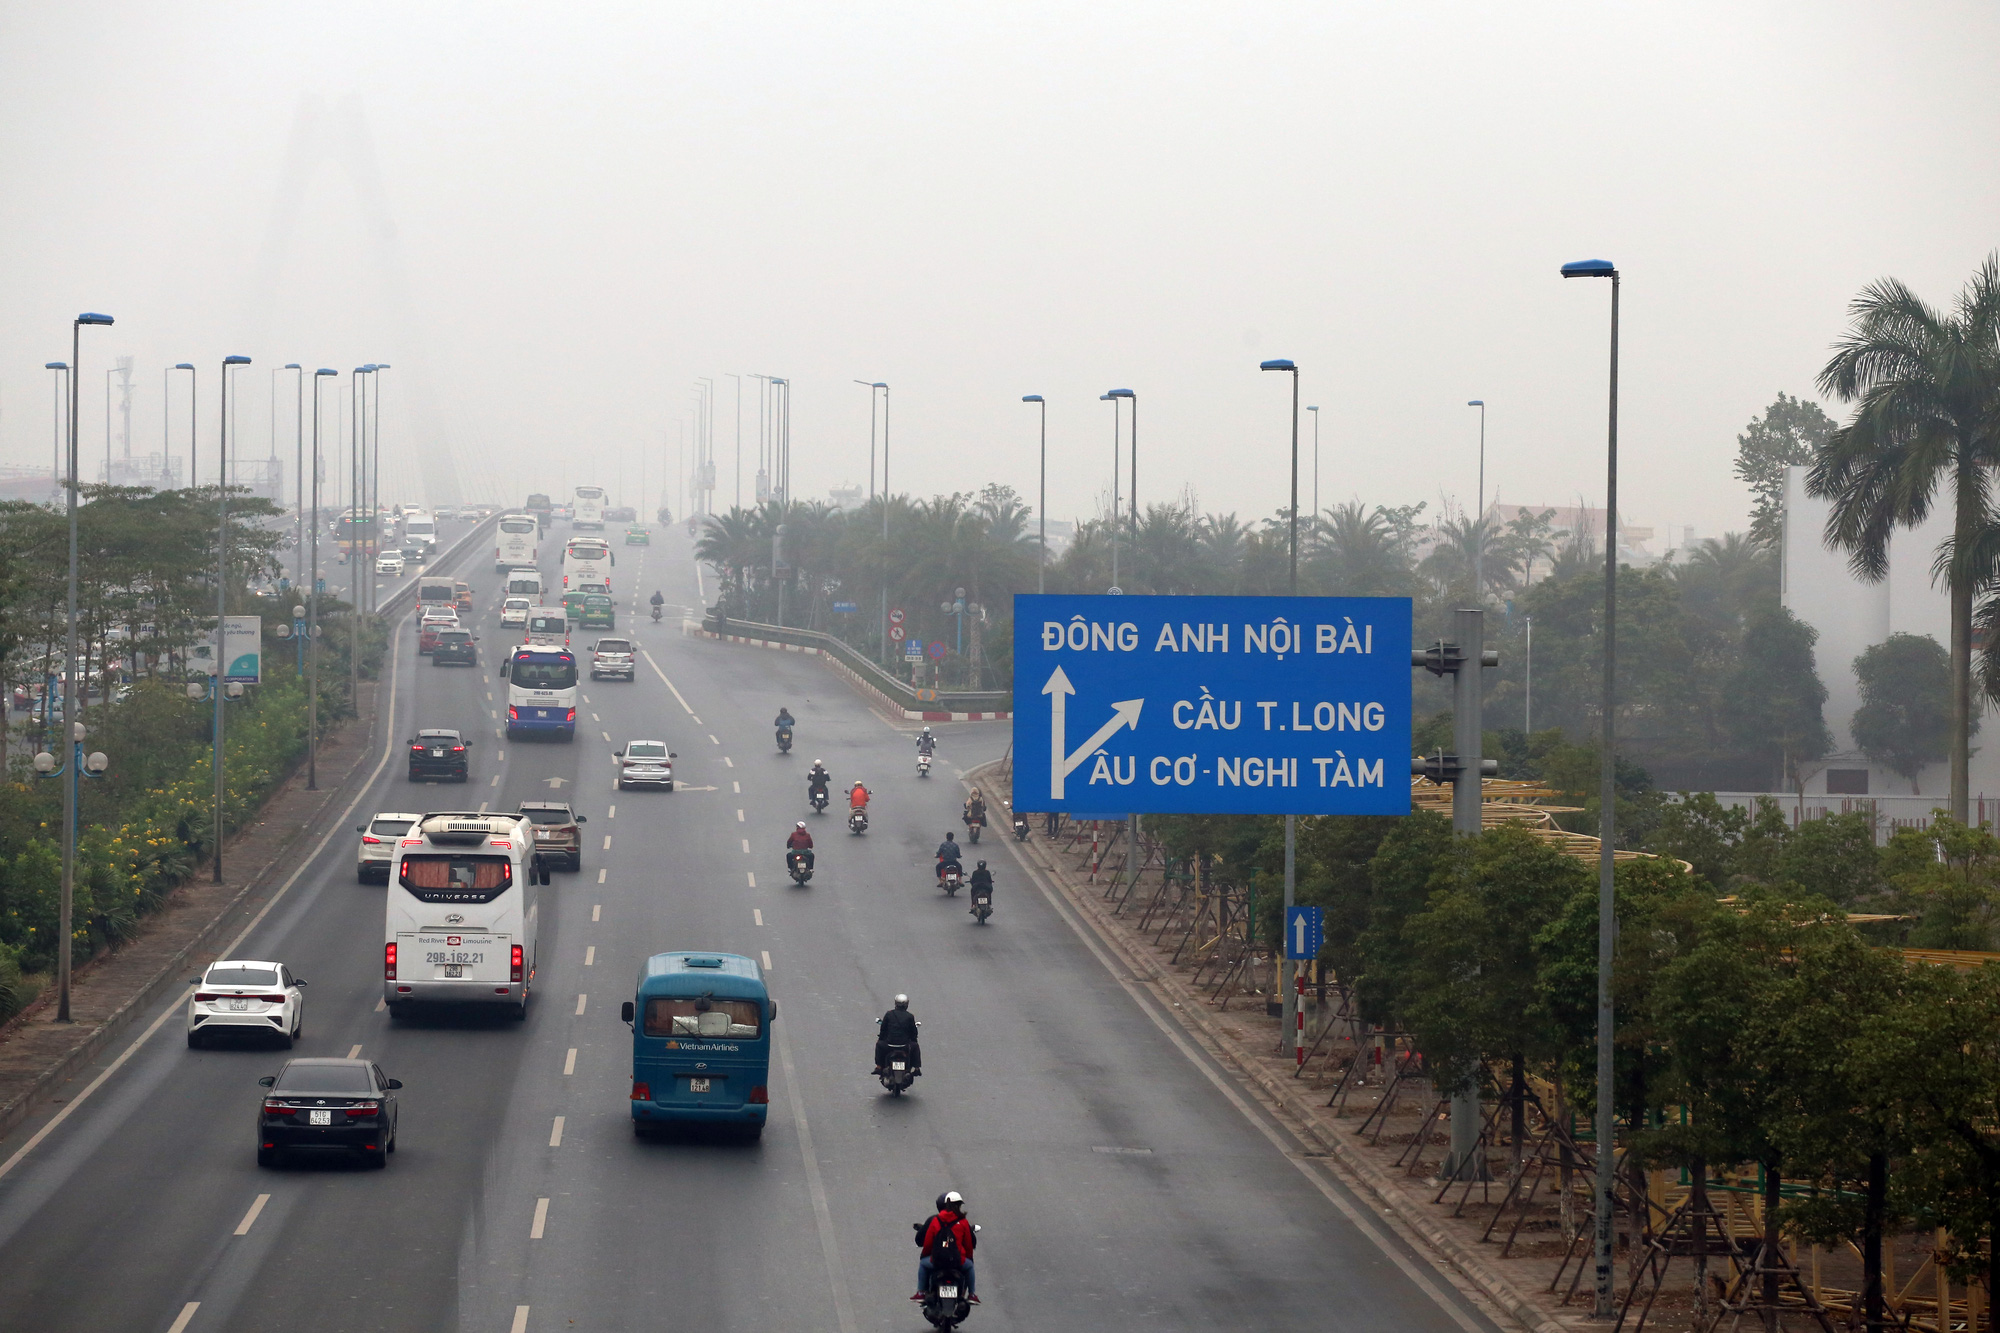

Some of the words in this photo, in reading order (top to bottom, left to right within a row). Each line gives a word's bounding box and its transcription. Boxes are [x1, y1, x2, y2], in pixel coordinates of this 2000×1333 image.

[1041, 614, 1139, 652] ĐÔNG
[1154, 622, 1229, 653] ANH
[1244, 616, 1301, 661] NỘI
[1315, 616, 1372, 654] BÀI
[1172, 685, 1242, 731] CẦU
[1088, 748, 1136, 786] ÂU
[1312, 750, 1384, 788] TÀM
[426, 952, 484, 964] 29B-162.21
[680, 1042, 711, 1051] Vietnam
[711, 1043, 739, 1052] Airlines
